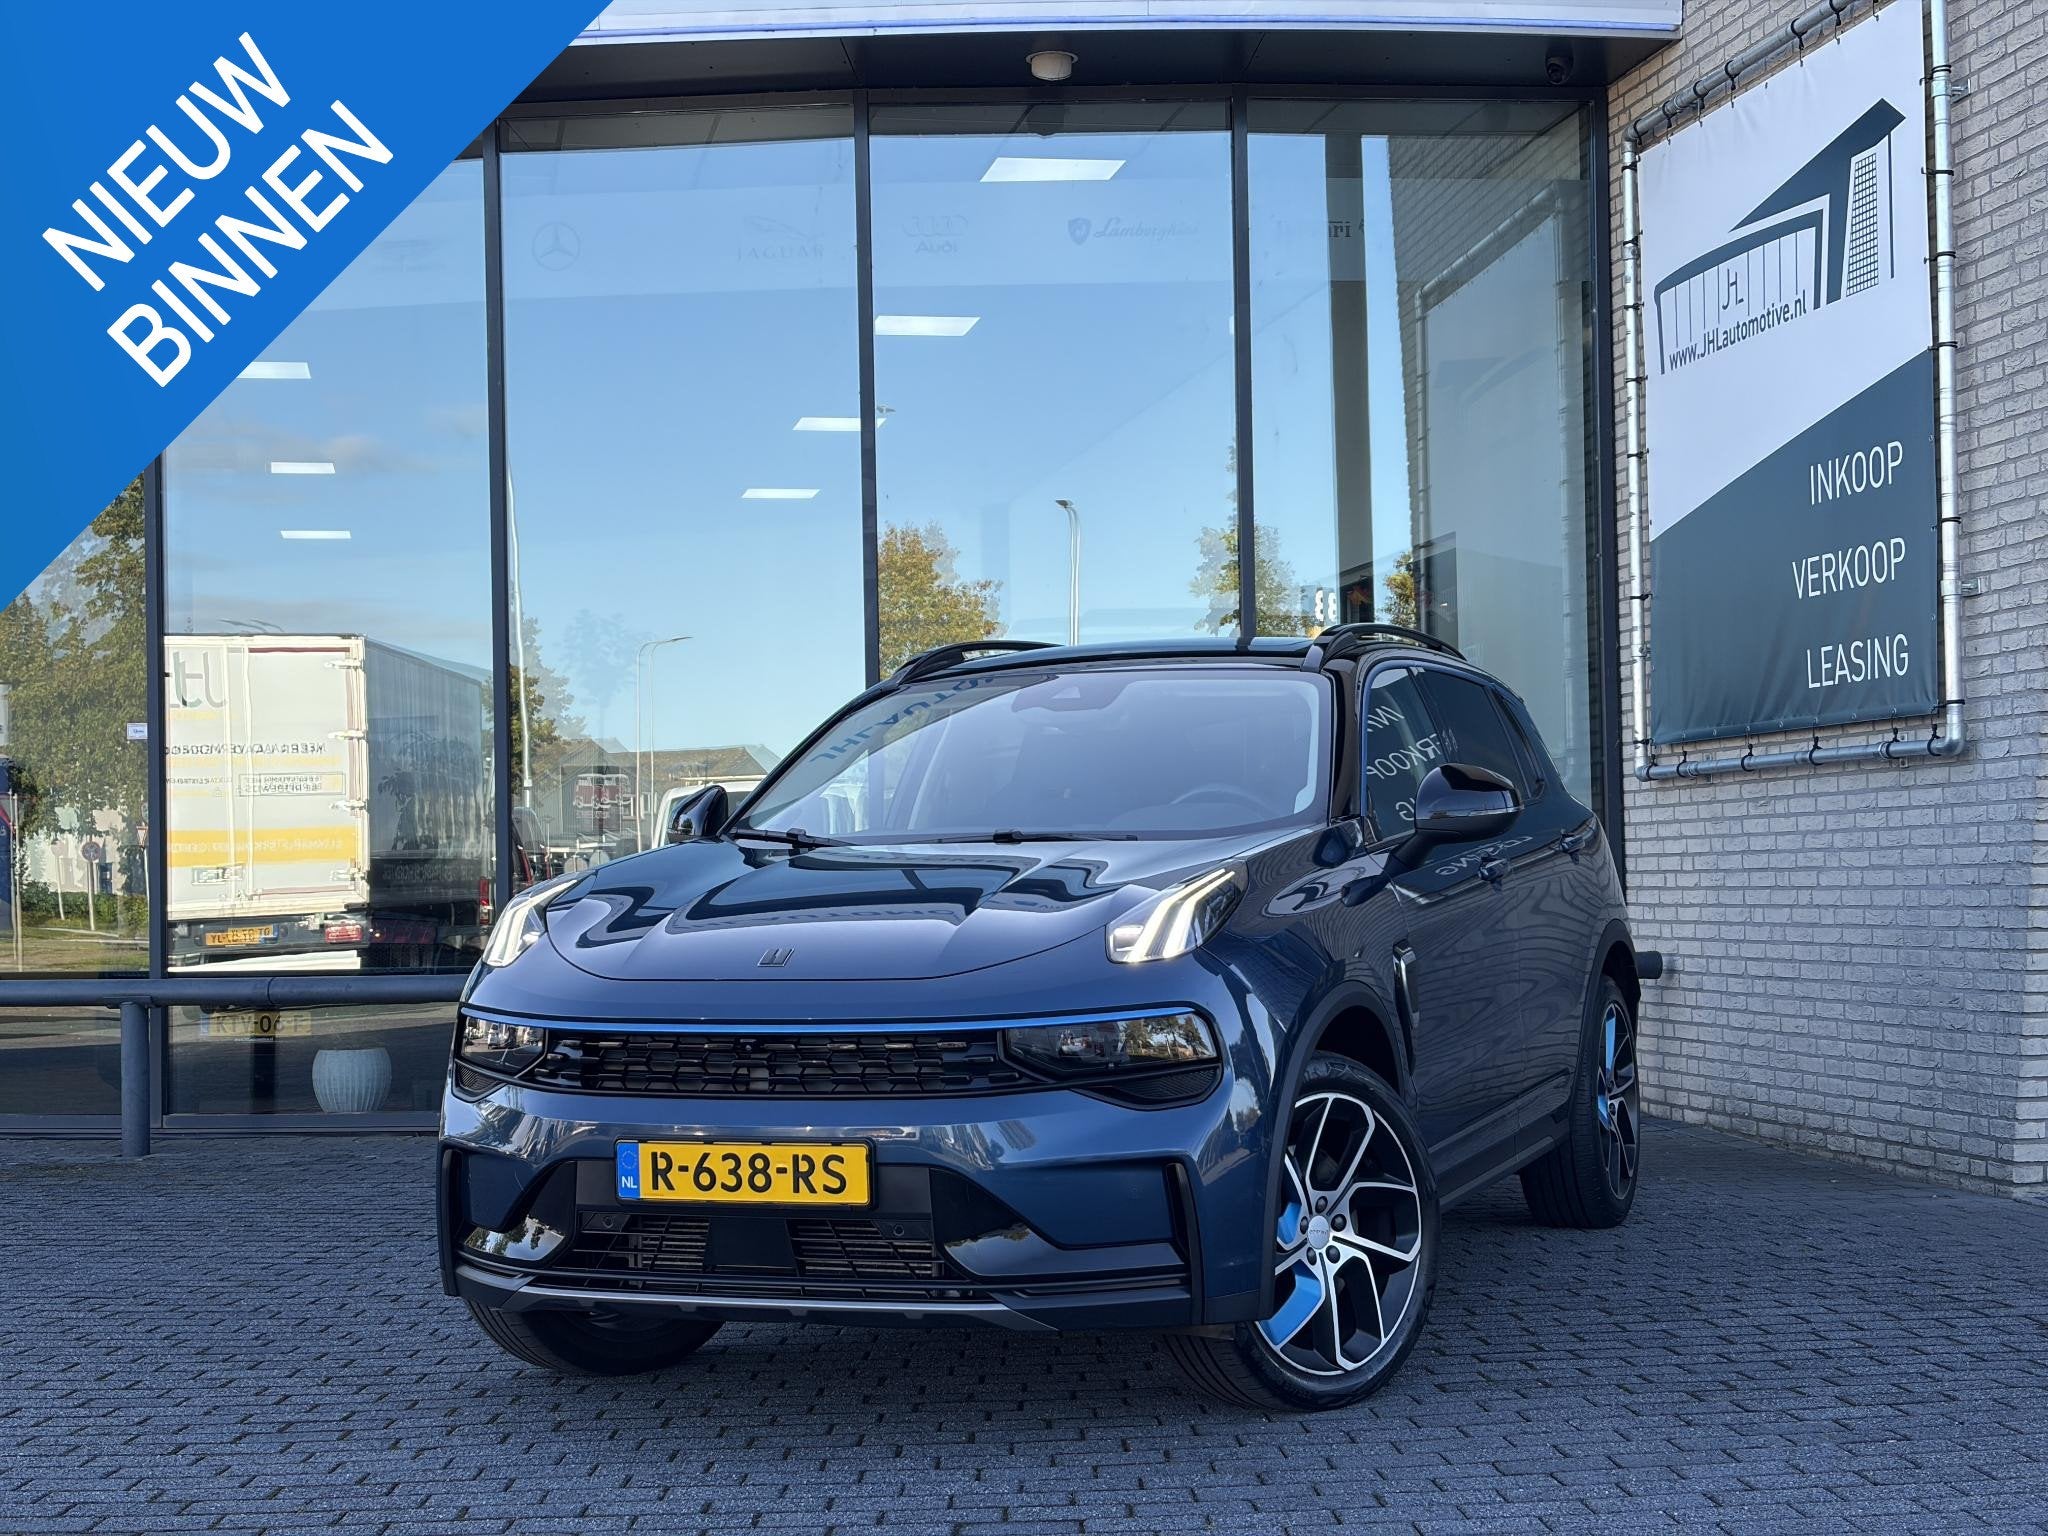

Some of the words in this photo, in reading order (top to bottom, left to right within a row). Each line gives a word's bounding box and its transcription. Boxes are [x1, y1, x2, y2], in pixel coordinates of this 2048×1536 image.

[1669, 289, 1807, 371] www.JHLautomotive.nl
[1810, 440, 1904, 506] INKOOP
[1792, 537, 1906, 600] VERKOOP
[1806, 633, 1909, 690] LEASING
[621, 1175, 638, 1189] NL
[650, 1151, 848, 1195] R-638-RS
